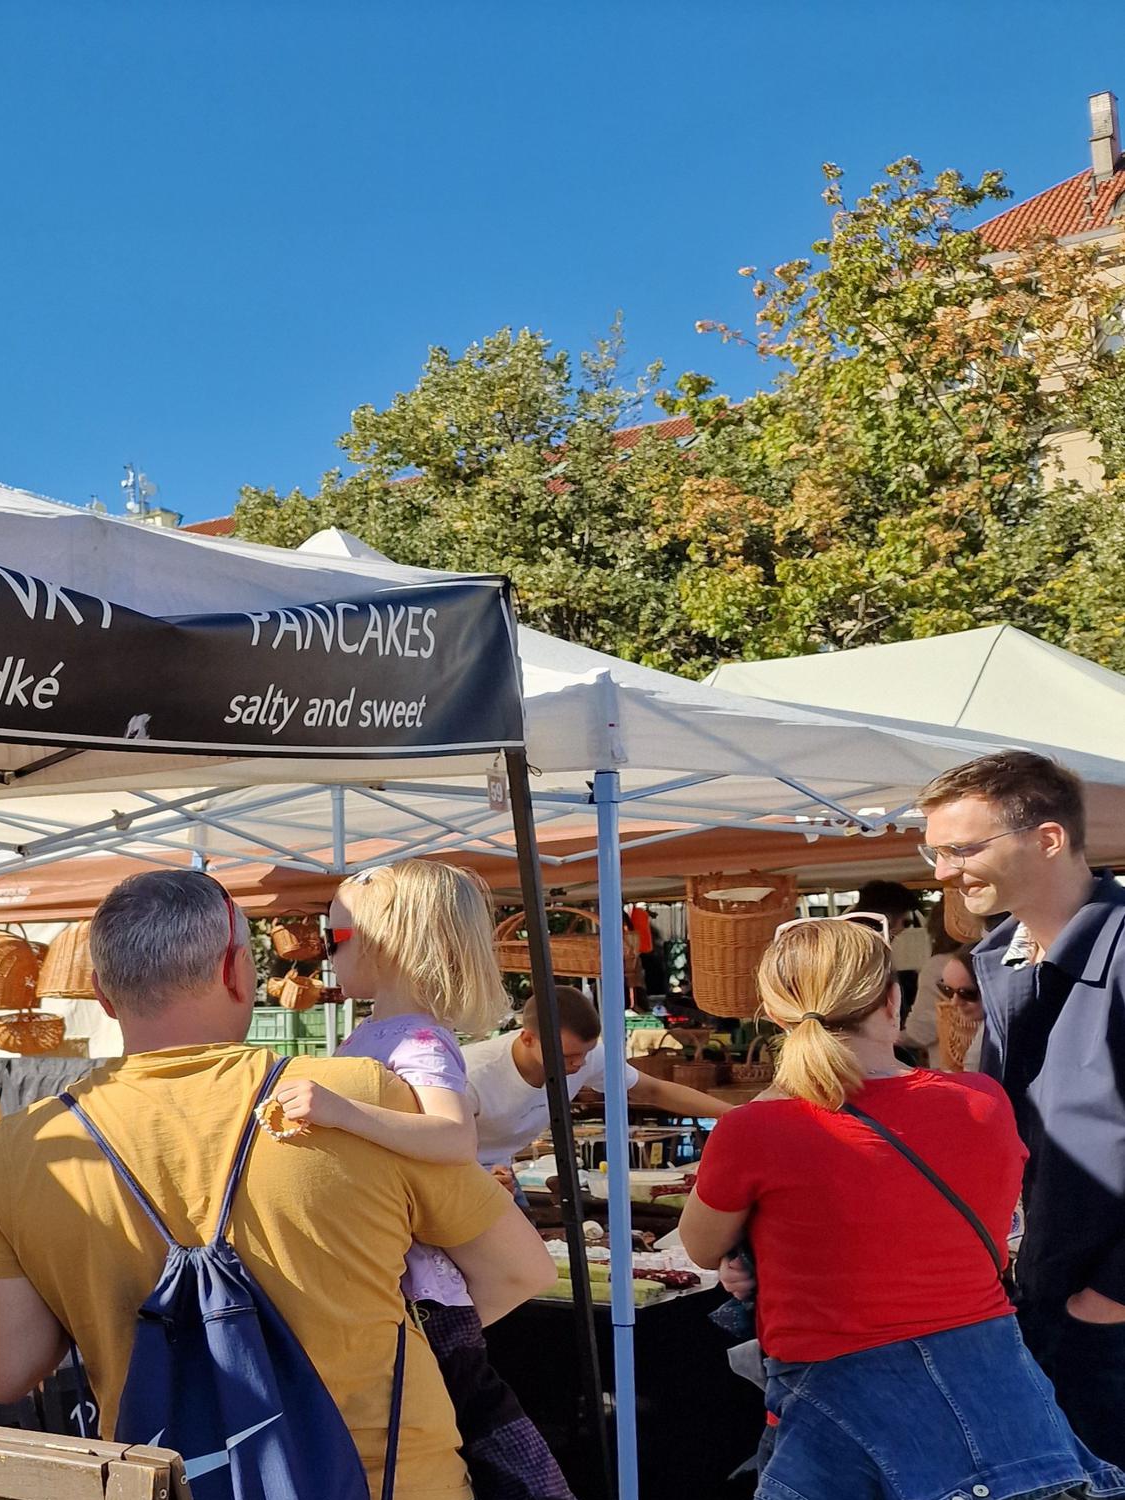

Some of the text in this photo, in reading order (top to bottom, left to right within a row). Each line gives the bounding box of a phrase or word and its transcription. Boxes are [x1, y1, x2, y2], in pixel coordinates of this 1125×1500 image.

[242, 602, 437, 660] PANCAKES
[223, 683, 426, 735] salty and sweet
[489, 781, 504, 802] 59
